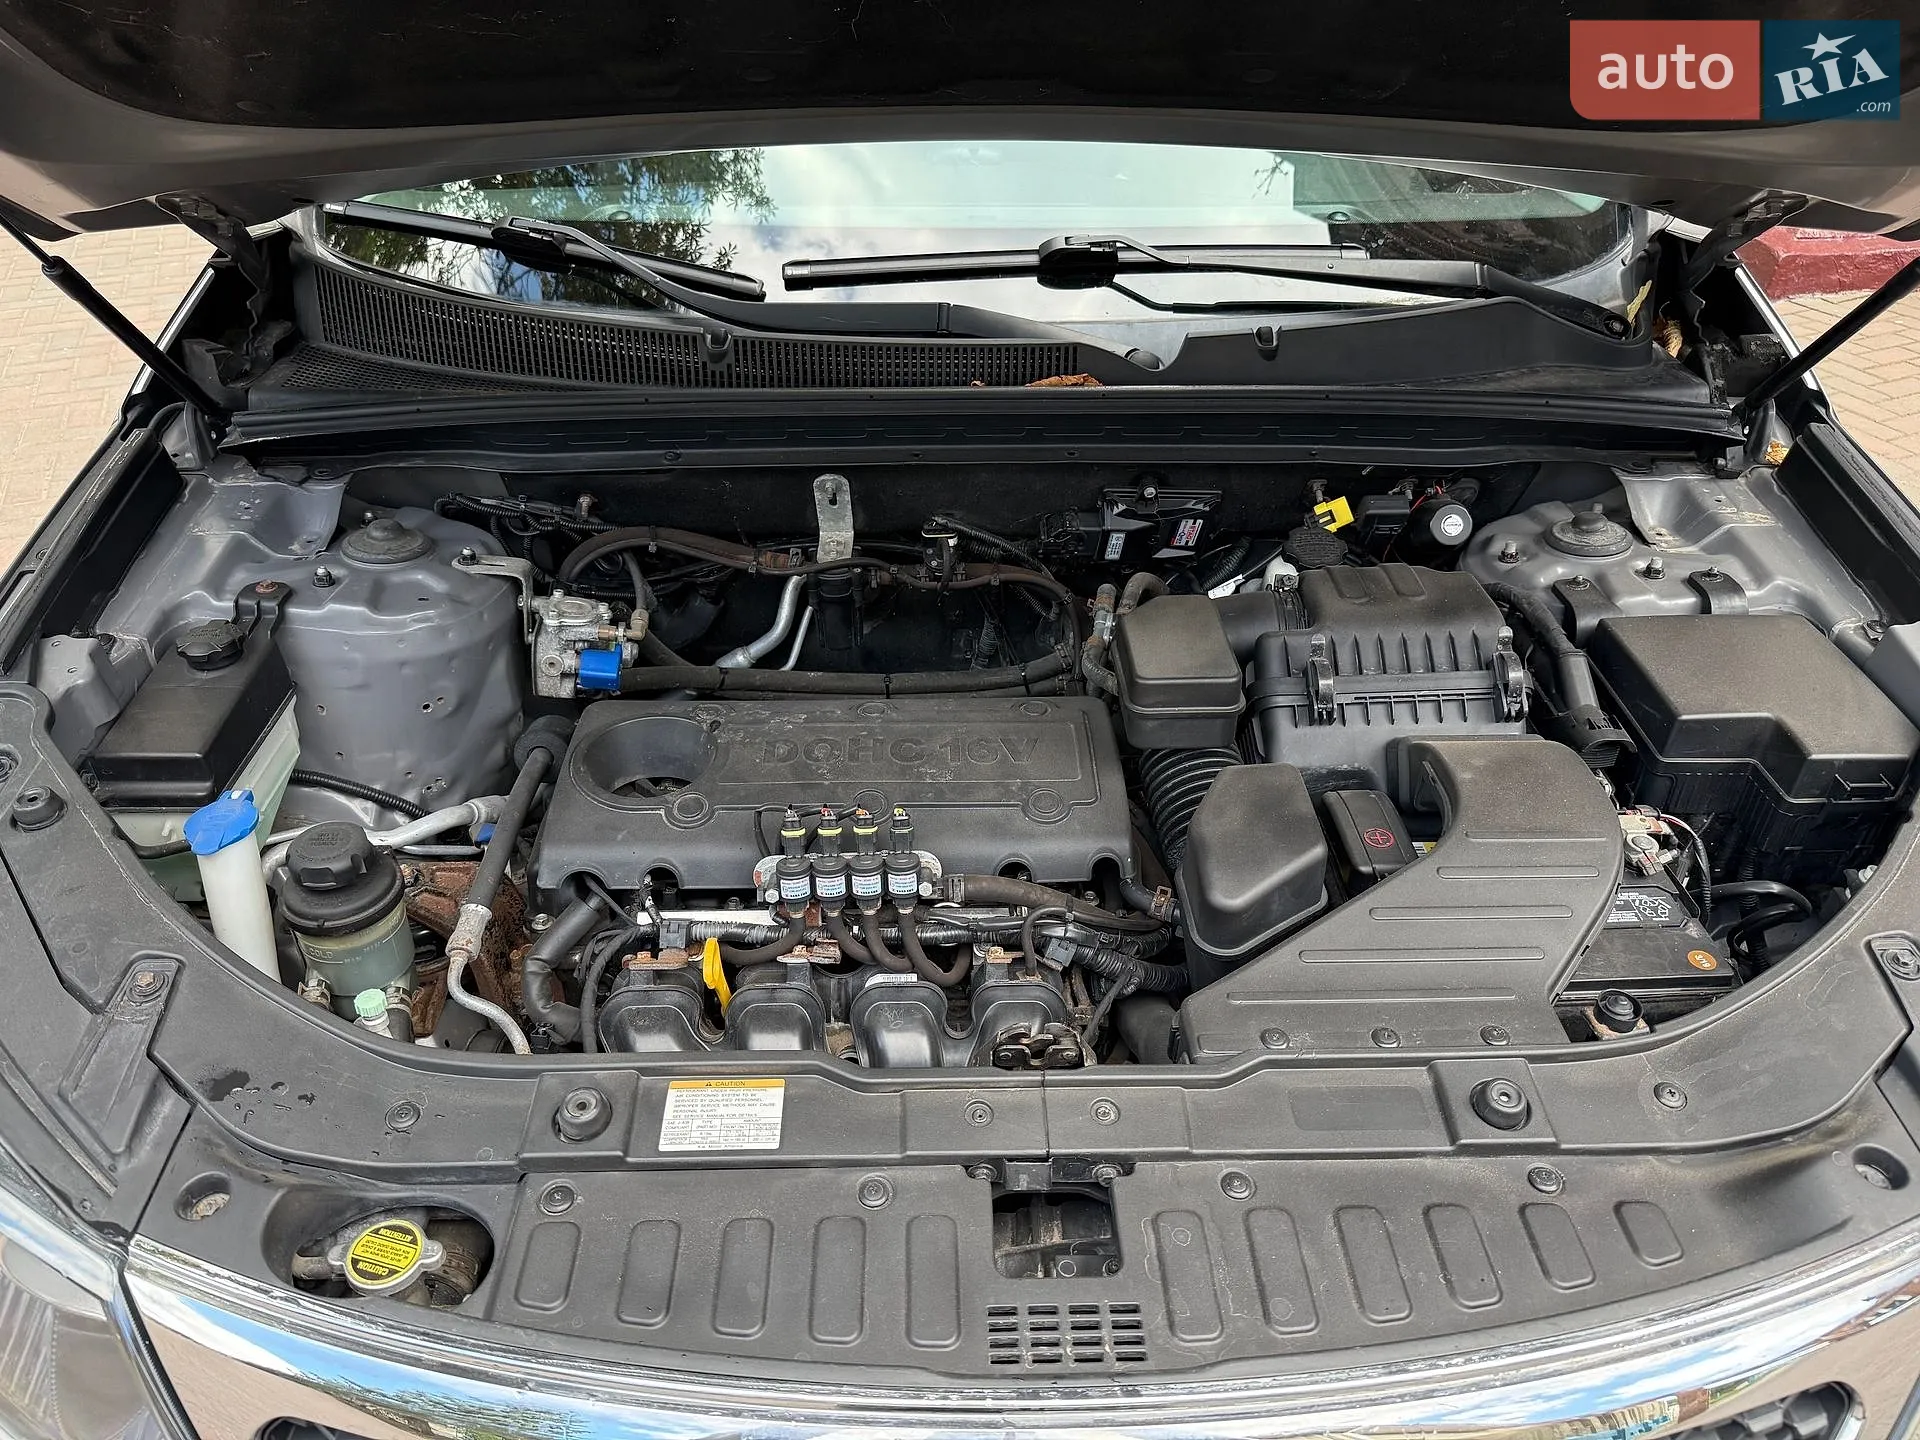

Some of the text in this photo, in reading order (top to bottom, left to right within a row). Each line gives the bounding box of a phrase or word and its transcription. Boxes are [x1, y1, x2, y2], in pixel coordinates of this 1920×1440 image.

[761, 736, 1040, 765] DOHC 16V
[308, 947, 334, 960] COLD
[378, 1228, 414, 1242] ATTENTION
[357, 1261, 390, 1276] CAUTION
